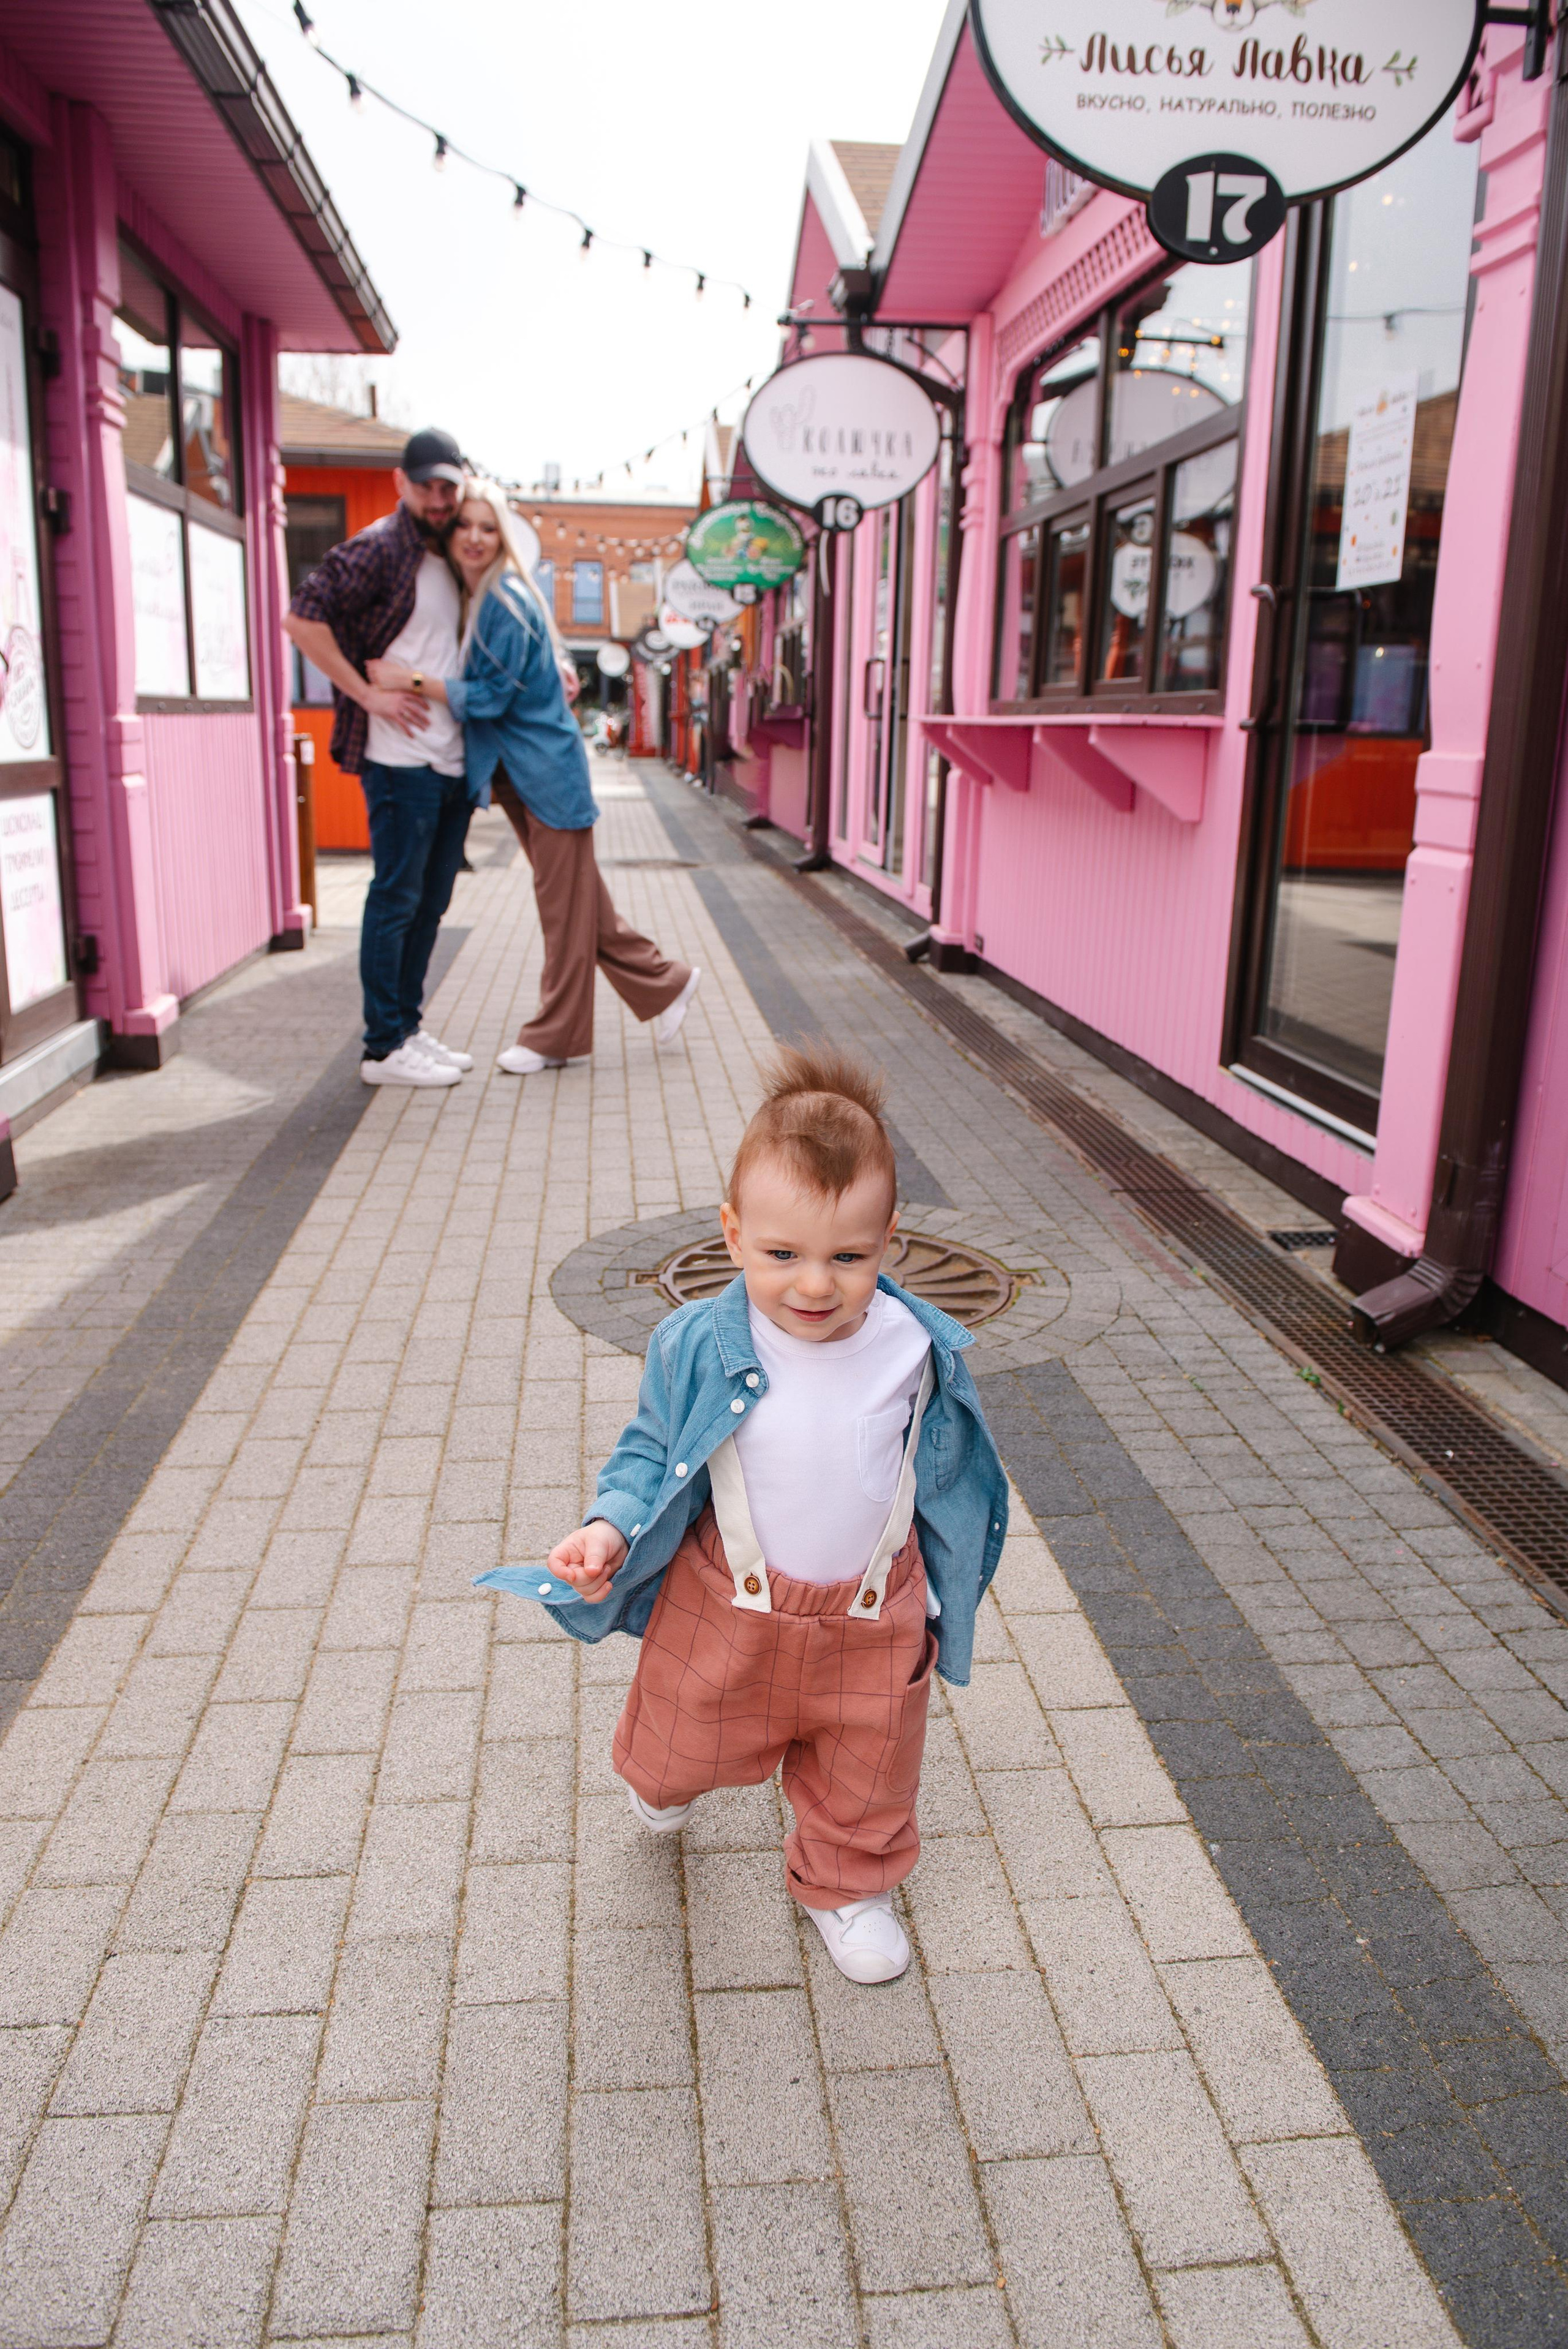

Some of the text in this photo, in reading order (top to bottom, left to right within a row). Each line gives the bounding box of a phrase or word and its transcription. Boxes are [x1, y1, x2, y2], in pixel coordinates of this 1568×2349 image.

[1079, 31, 1377, 88] Лисья Лавка
[1076, 93, 1377, 121] ВКУСНО, НАТУРАЛЬНО, ПОЛЕЗНО
[1185, 170, 1267, 245] 17
[821, 496, 860, 530] 16
